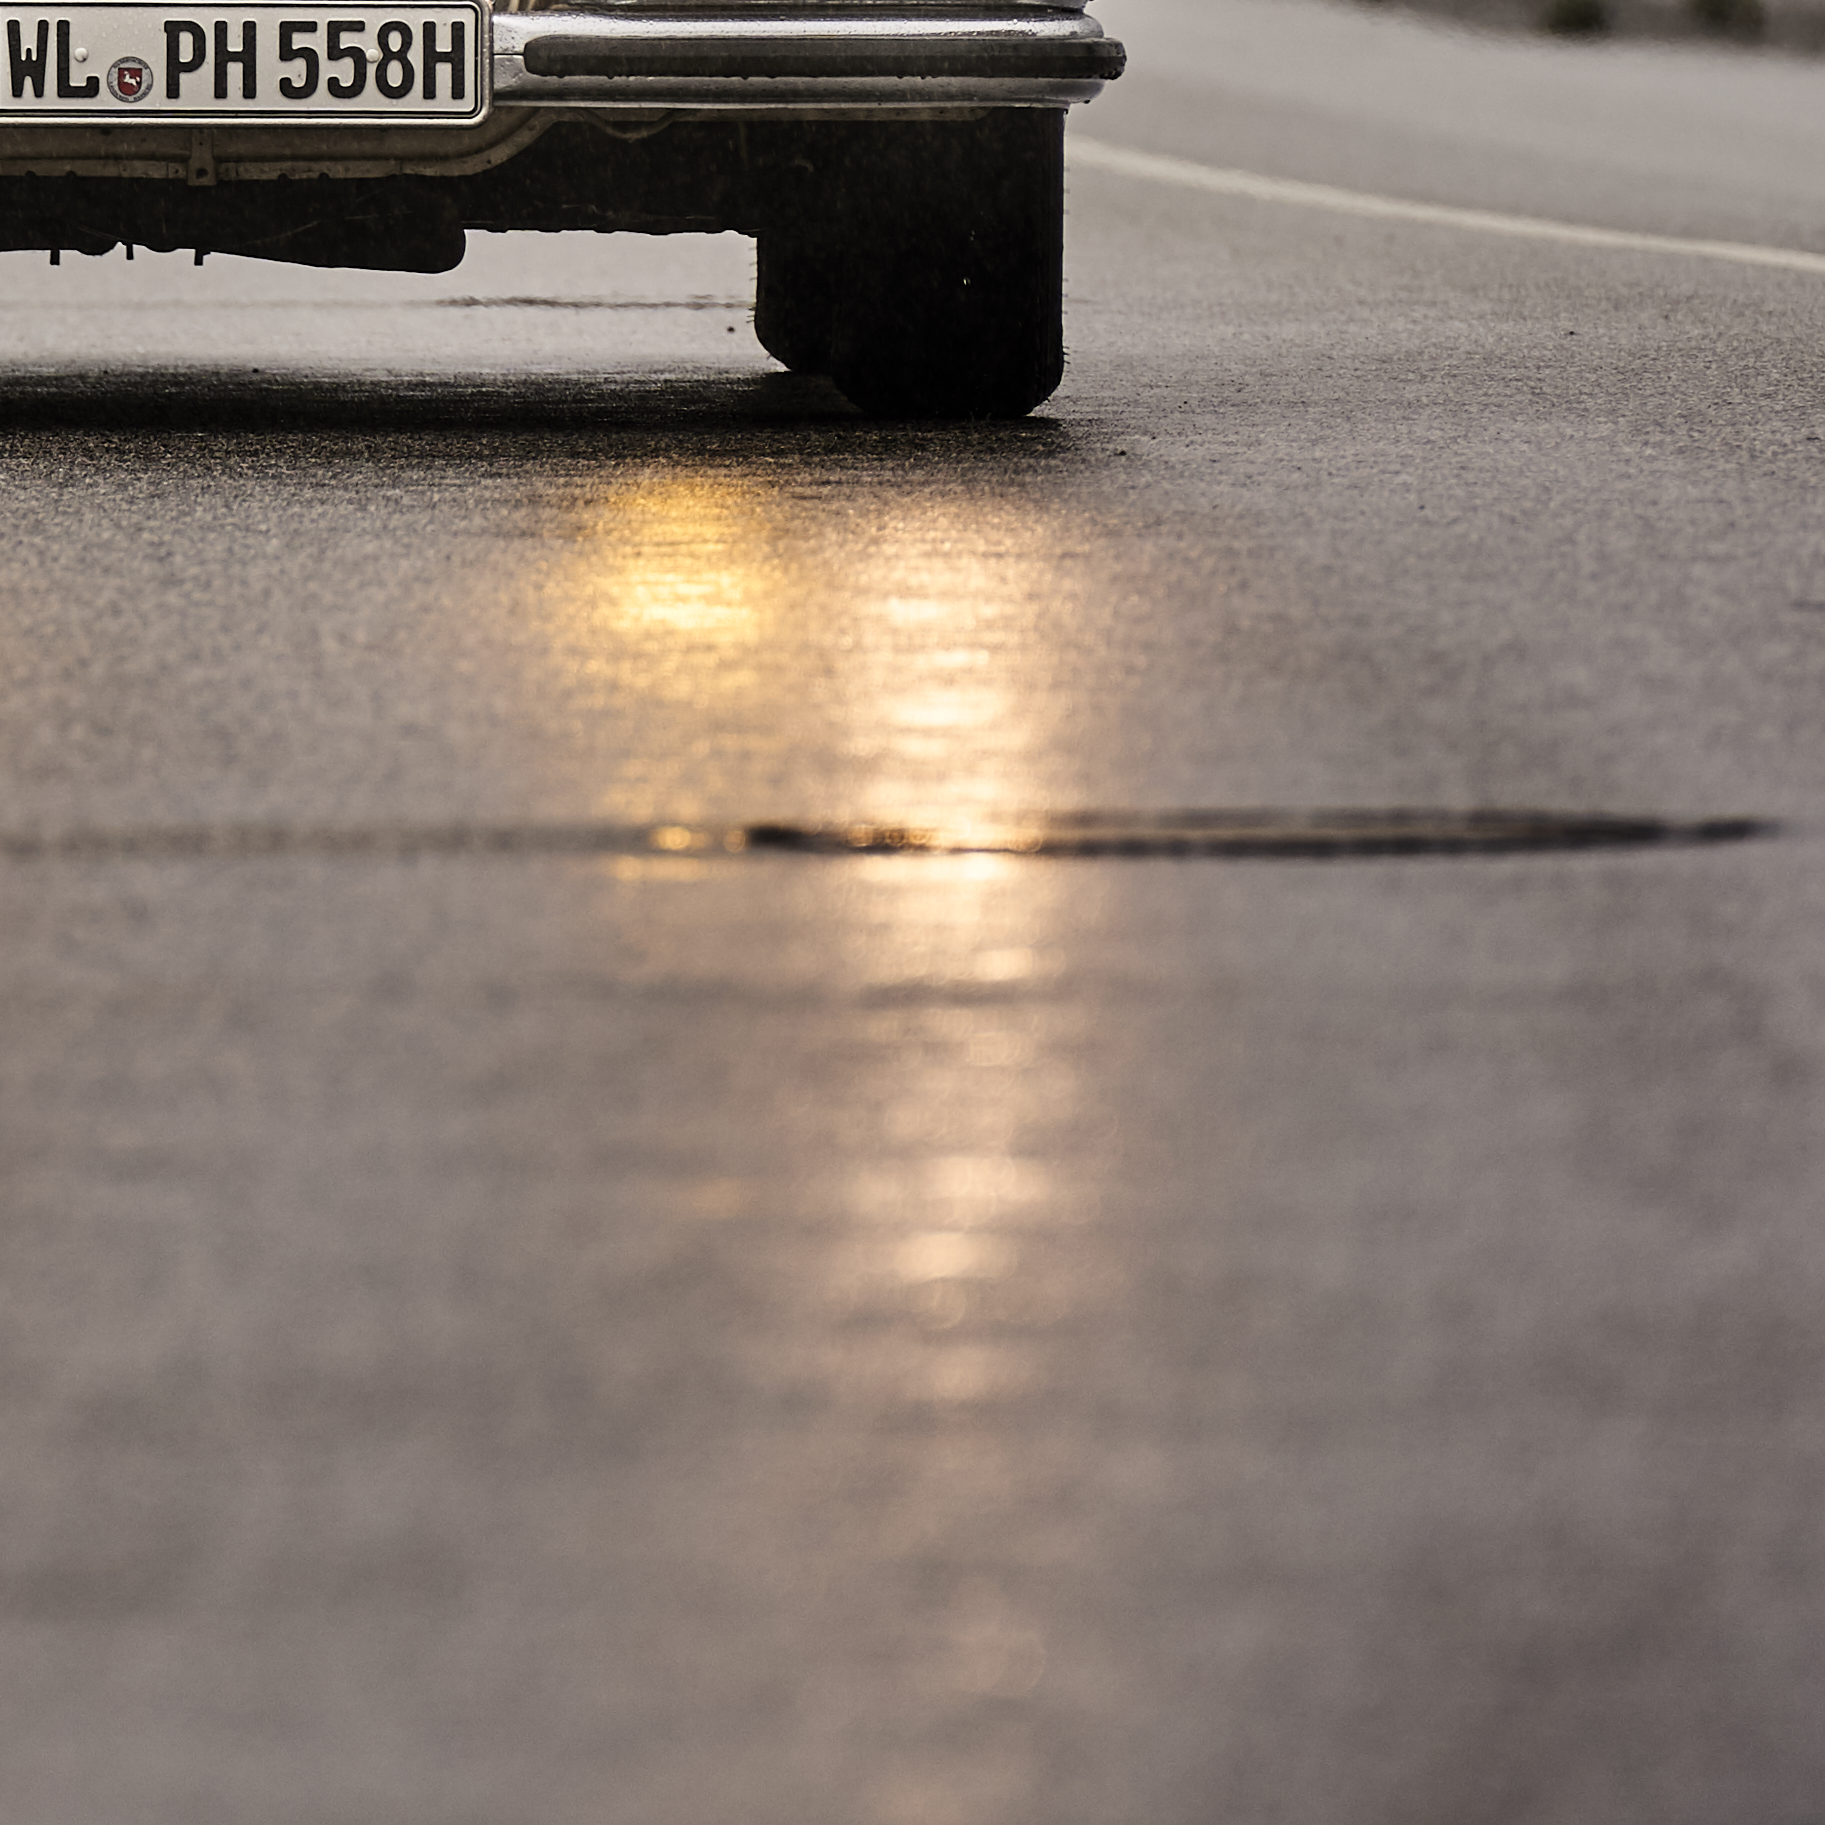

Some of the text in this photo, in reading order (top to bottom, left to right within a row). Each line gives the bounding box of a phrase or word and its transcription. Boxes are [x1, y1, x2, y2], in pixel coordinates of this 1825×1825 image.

[7, 19, 100, 99] WL
[164, 20, 257, 100] PH
[279, 20, 466, 100] 558H
